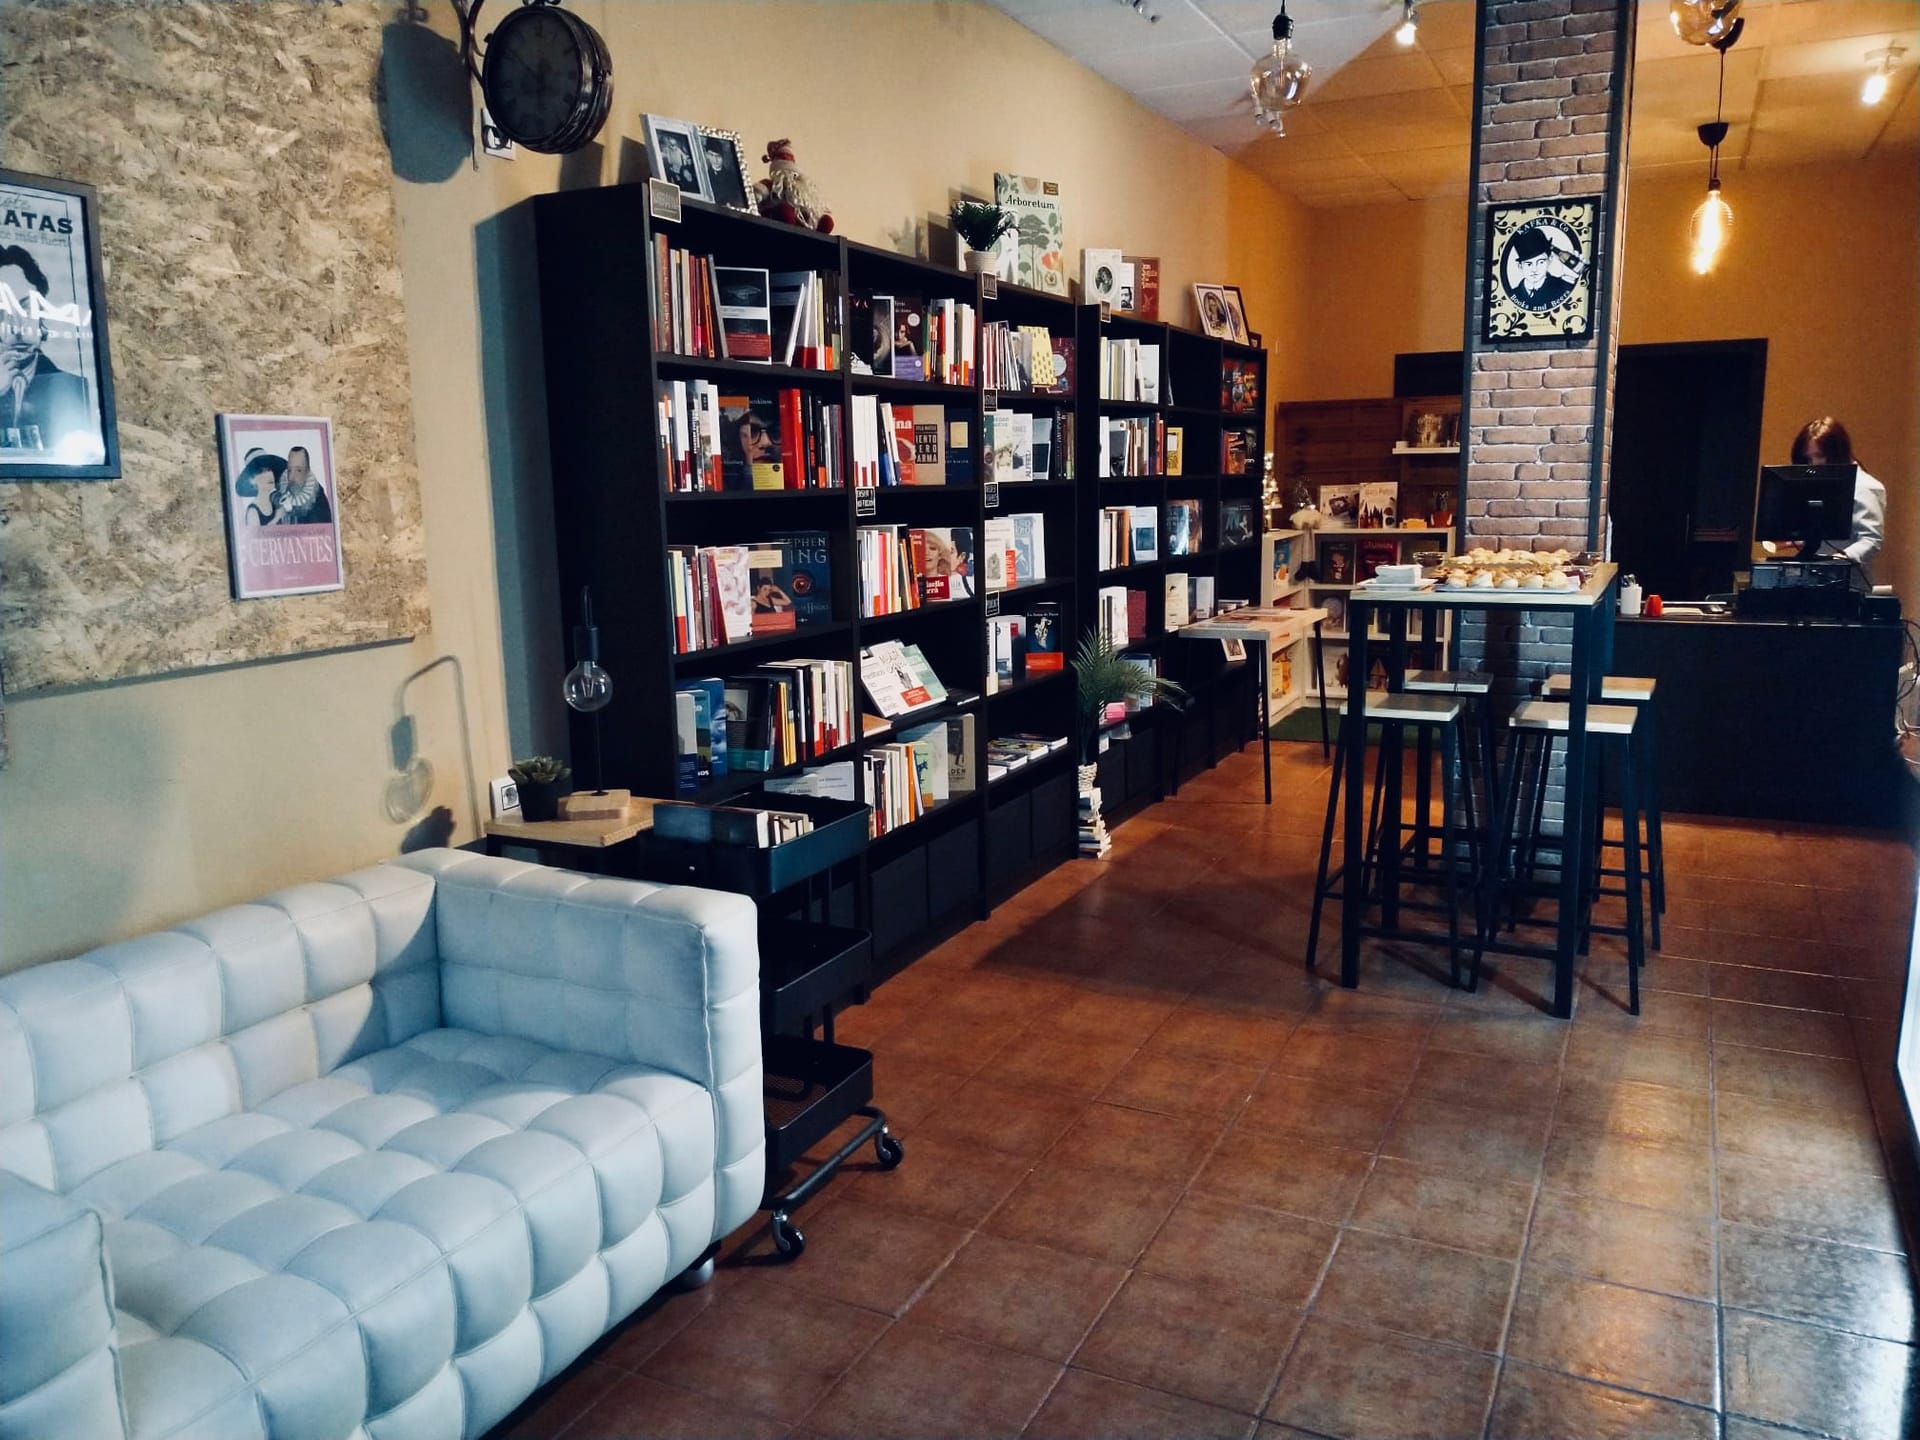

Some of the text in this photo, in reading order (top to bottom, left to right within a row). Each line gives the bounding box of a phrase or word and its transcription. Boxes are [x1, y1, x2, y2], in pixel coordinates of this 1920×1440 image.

[1005, 194, 1056, 210] Arboretum
[0, 208, 73, 234] ATAS
[1517, 218, 1549, 236] KAFKA
[1559, 222, 1569, 233] Co
[1510, 290, 1571, 311] Books and Beers
[244, 535, 333, 567] CERVANTES
[790, 548, 827, 565] ING
